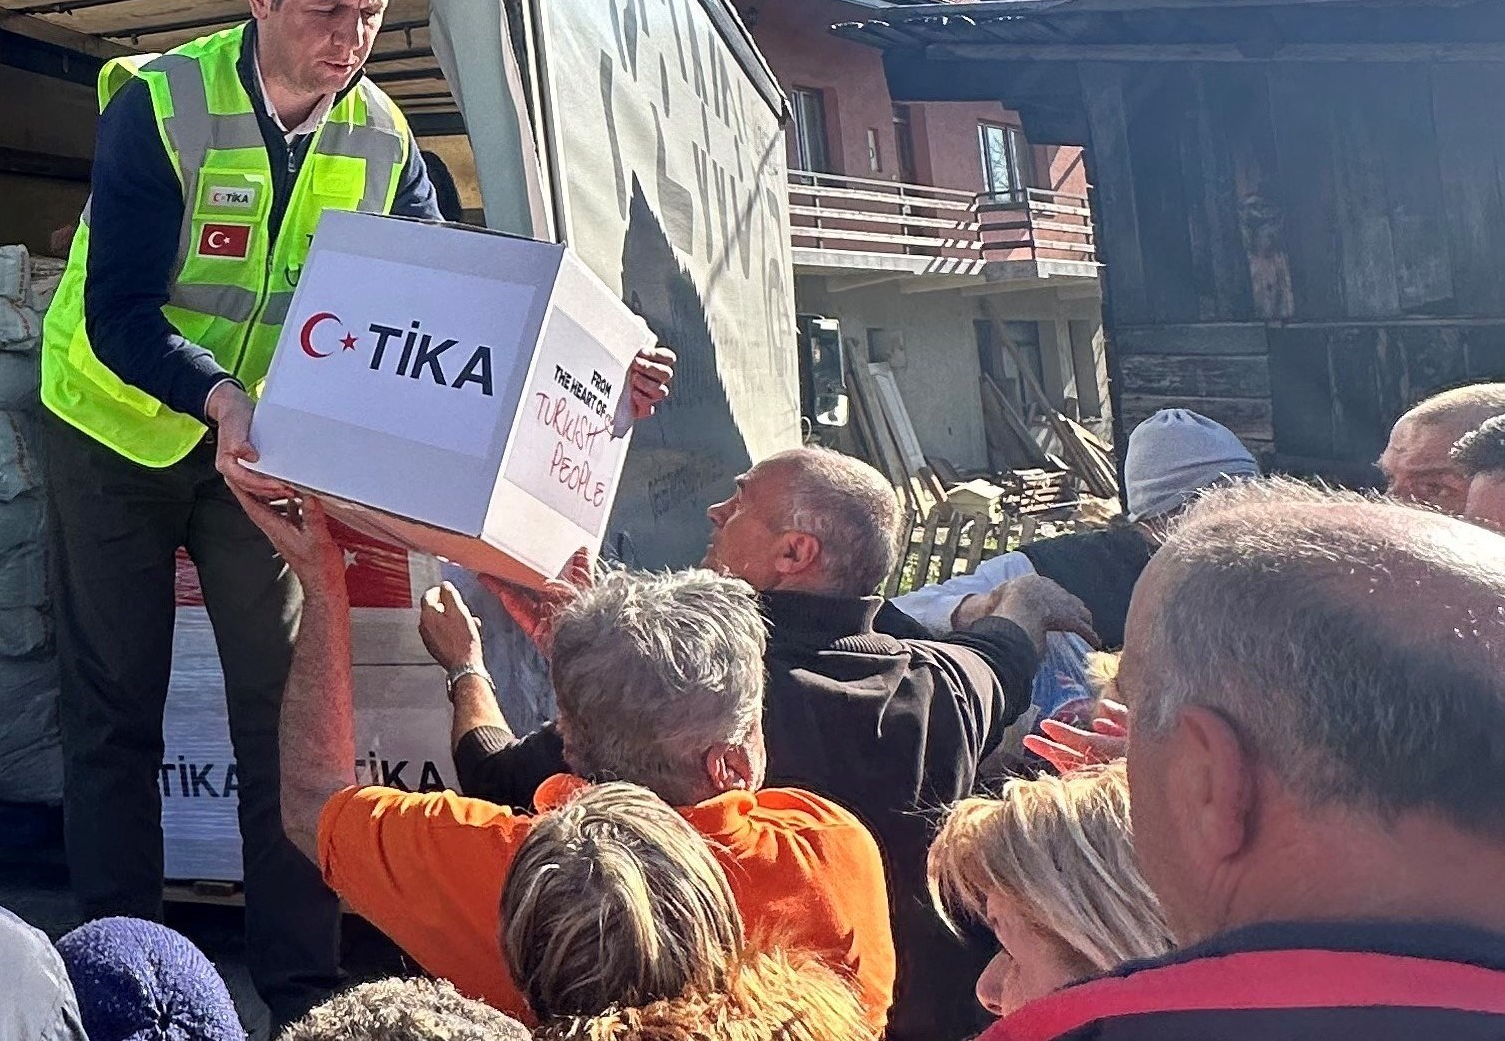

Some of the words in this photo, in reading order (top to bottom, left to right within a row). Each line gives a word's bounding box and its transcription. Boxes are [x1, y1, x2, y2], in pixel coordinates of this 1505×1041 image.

[226, 191, 248, 204] TİKA
[368, 320, 493, 396] TİKA
[591, 369, 612, 399] FROM
[553, 364, 572, 390] THE
[569, 377, 598, 411] HEART
[595, 399, 608, 418] OF
[536, 392, 599, 456] TURKISH
[550, 441, 605, 507] PEOPLE
